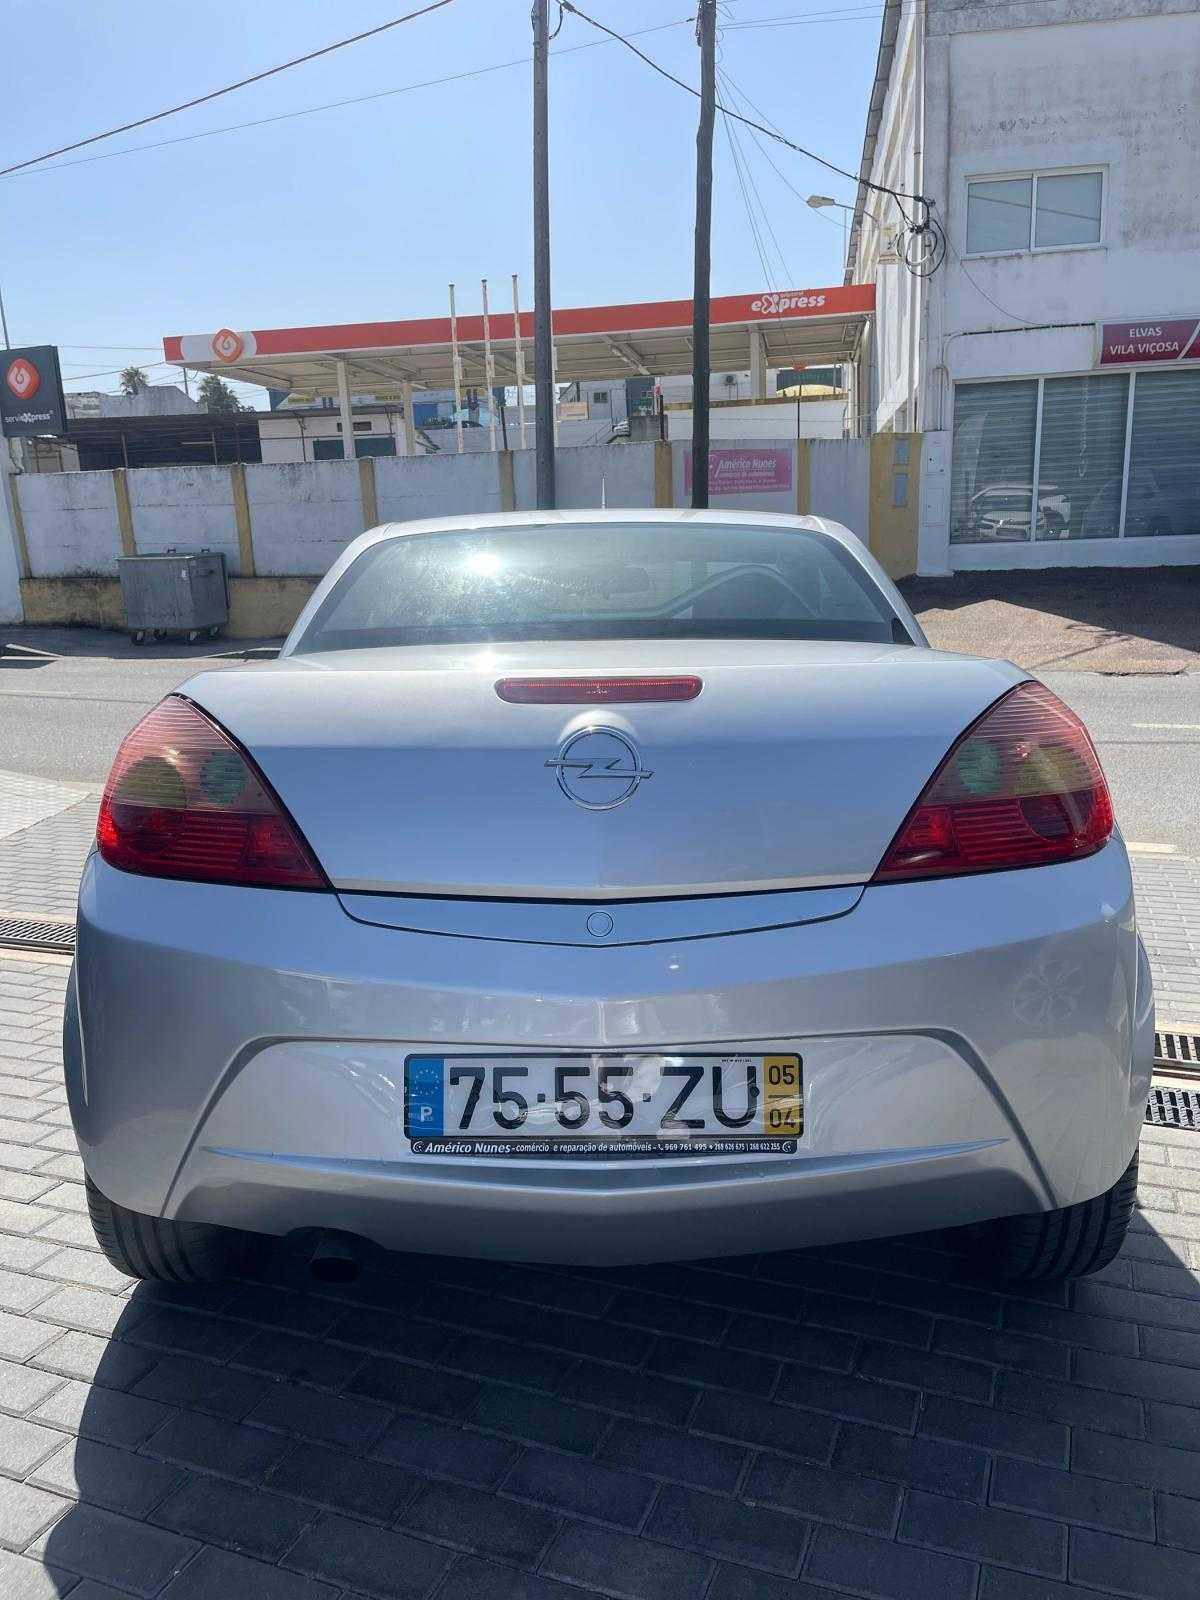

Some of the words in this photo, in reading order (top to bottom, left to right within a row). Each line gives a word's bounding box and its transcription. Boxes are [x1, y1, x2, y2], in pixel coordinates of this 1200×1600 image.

[1129, 326, 1162, 338] ELVAS
[1110, 344, 1135, 355] VILA
[1138, 341, 1179, 354] VIÇOSA
[768, 1064, 795, 1086] 05
[420, 1106, 433, 1123] P
[769, 1108, 796, 1129] 04
[424, 1141, 472, 1153] Américo
[474, 1142, 512, 1153] Nunes
[553, 1144, 558, 1152] e
[559, 1142, 597, 1153] reparação
[598, 1142, 607, 1152] de
[609, 1142, 652, 1152] automóveis
